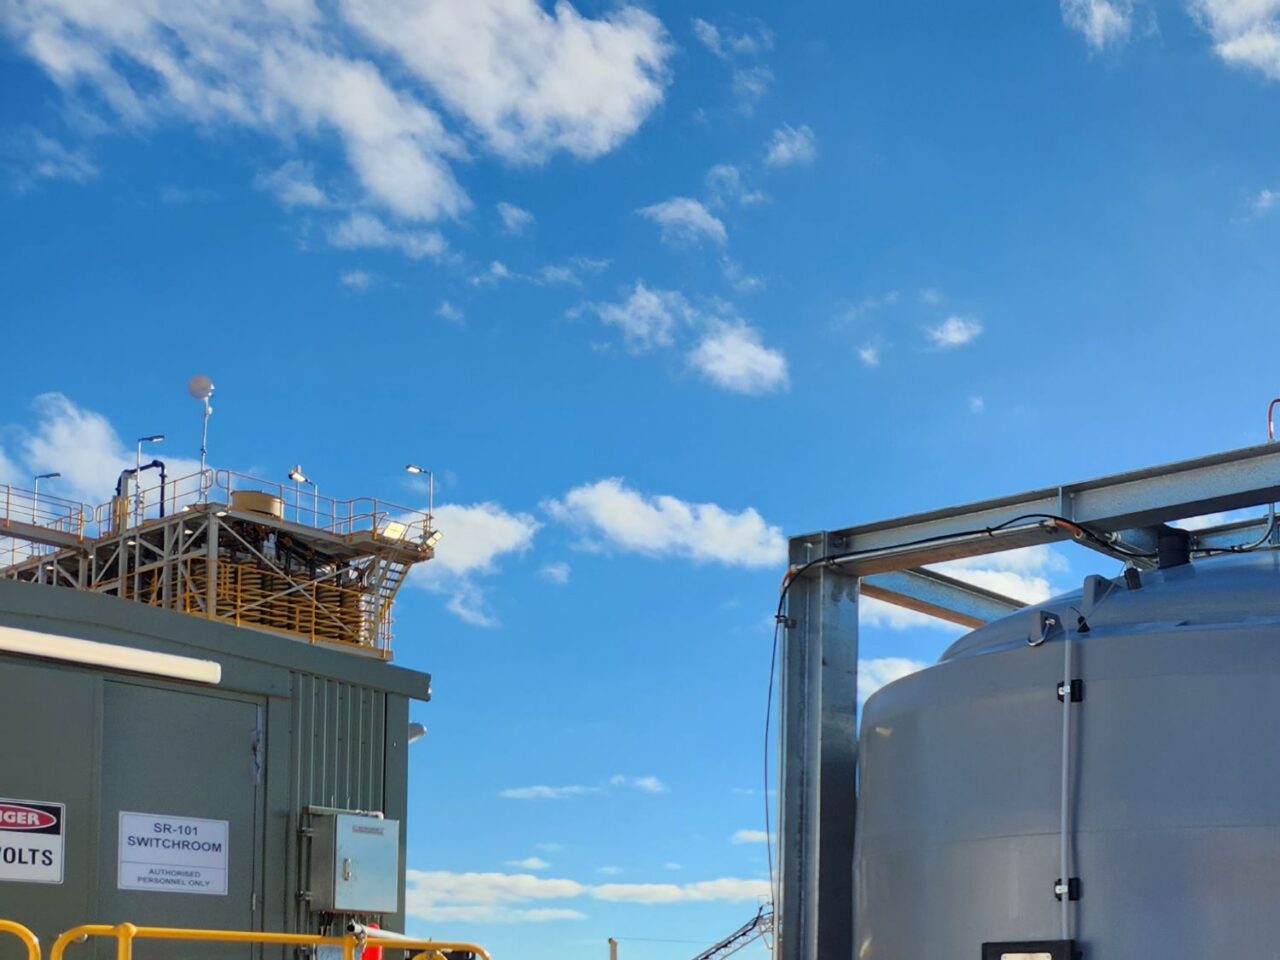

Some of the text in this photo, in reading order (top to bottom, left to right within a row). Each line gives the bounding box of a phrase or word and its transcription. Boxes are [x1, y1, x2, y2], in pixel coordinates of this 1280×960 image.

[0, 810, 40, 825] GER
[153, 822, 198, 836] SR-101
[127, 835, 222, 853] SWITCHROOM
[0, 846, 53, 866] OLTS
[148, 868, 201, 878] AUTHORISED
[137, 876, 186, 886] PERSONNEL
